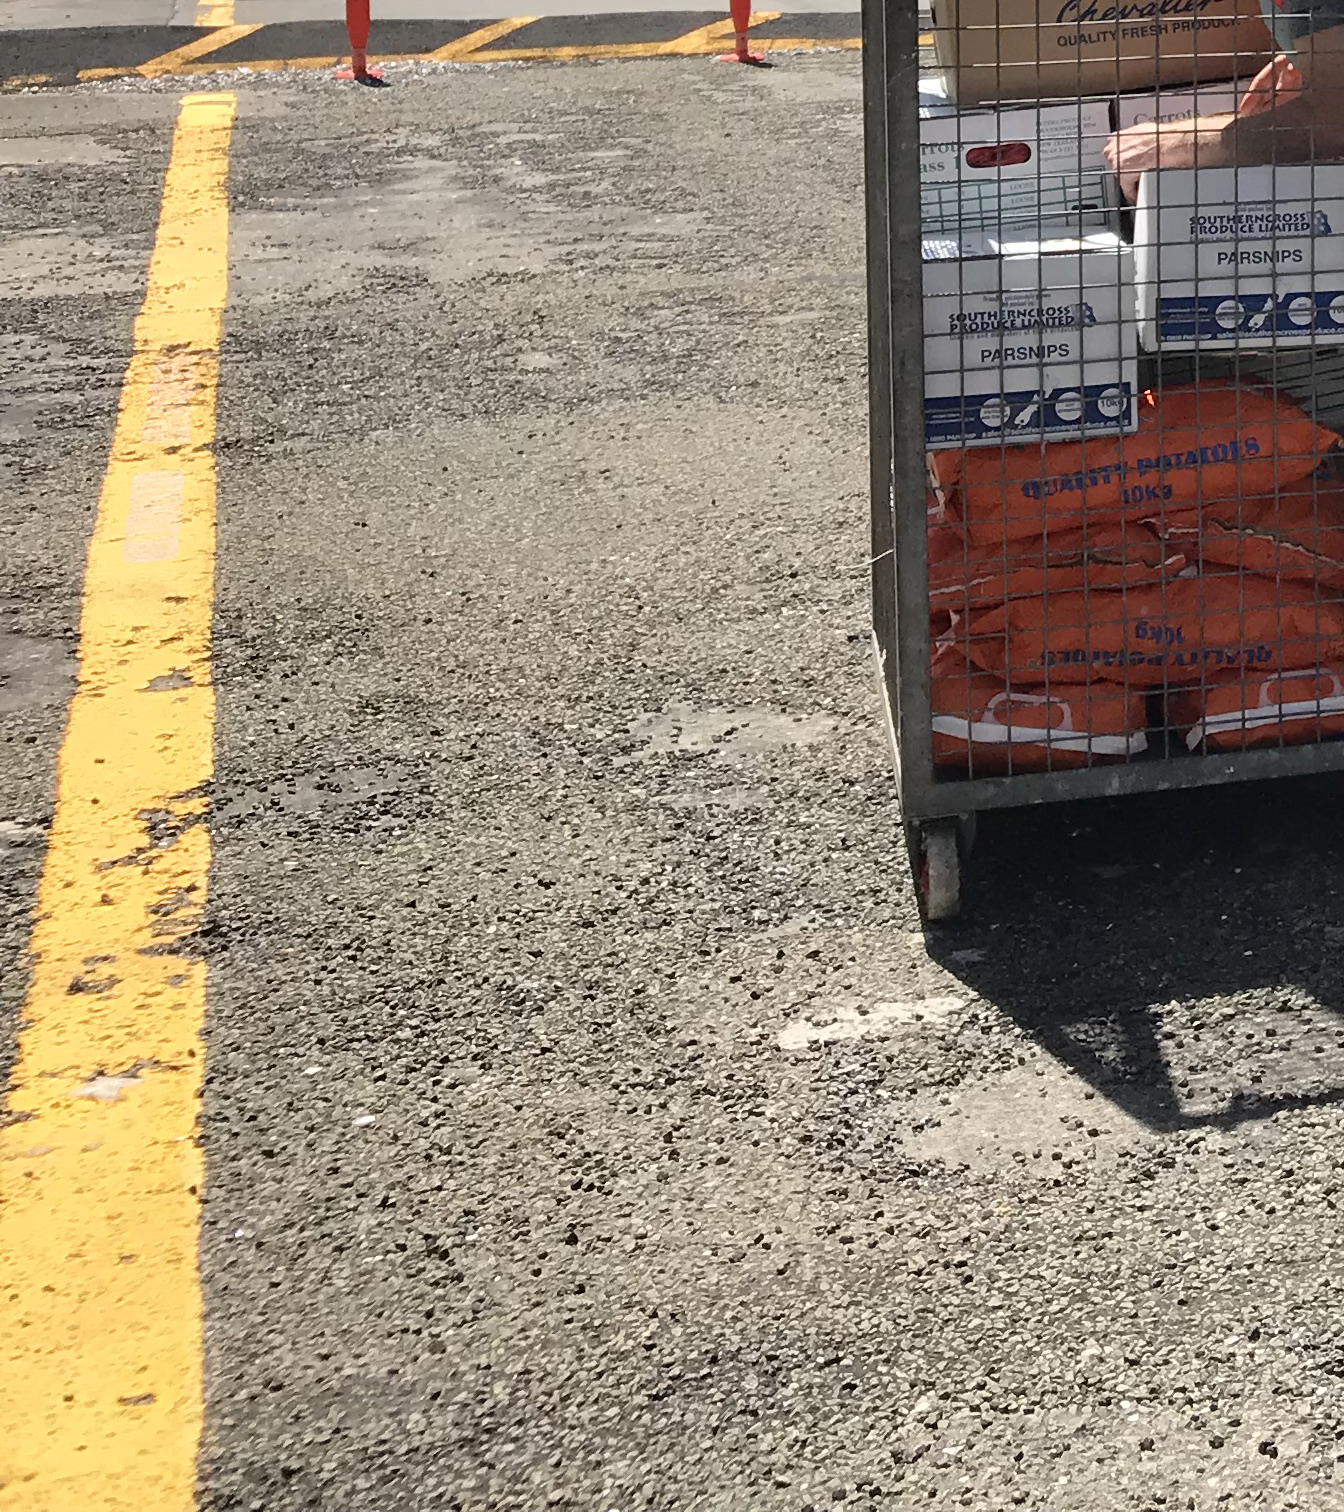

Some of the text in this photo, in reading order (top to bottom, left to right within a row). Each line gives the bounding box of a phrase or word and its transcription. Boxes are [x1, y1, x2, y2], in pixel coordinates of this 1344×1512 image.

[1057, 29, 1118, 47] QUALITY
[1121, 24, 1168, 40] FRESH
[1189, 213, 1306, 226] SOUTHERNCROSS
[1190, 222, 1311, 235] PRODUCE LIMITED
[1217, 249, 1303, 265] PARSNIPS
[949, 305, 1071, 324] SOUTHERNCROSS
[950, 320, 1017, 333] PRODUCE
[1021, 316, 1075, 328] LIMITED
[981, 343, 1070, 362] PARSNIPS
[1021, 437, 1261, 500] QUALITY POTATOES
